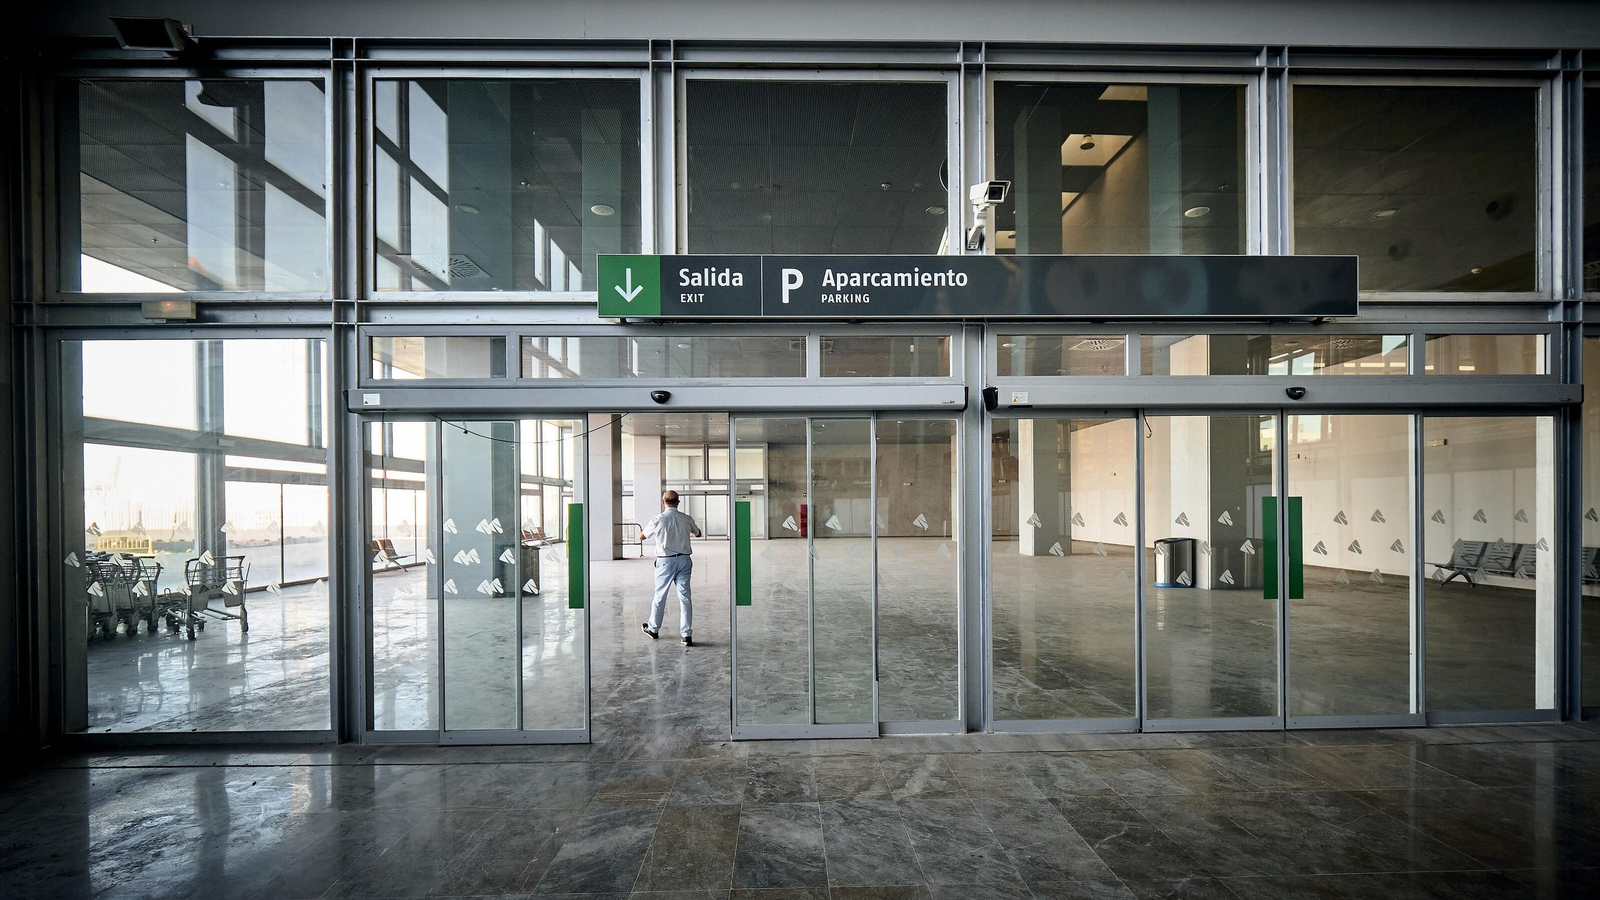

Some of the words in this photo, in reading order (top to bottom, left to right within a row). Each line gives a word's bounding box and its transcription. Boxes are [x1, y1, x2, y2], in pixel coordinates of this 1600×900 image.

[678, 267, 744, 287] Salida
[781, 268, 804, 304] P
[821, 267, 968, 291] Aparcamiento
[680, 293, 705, 304] EXIT
[821, 293, 871, 304] PARKING
